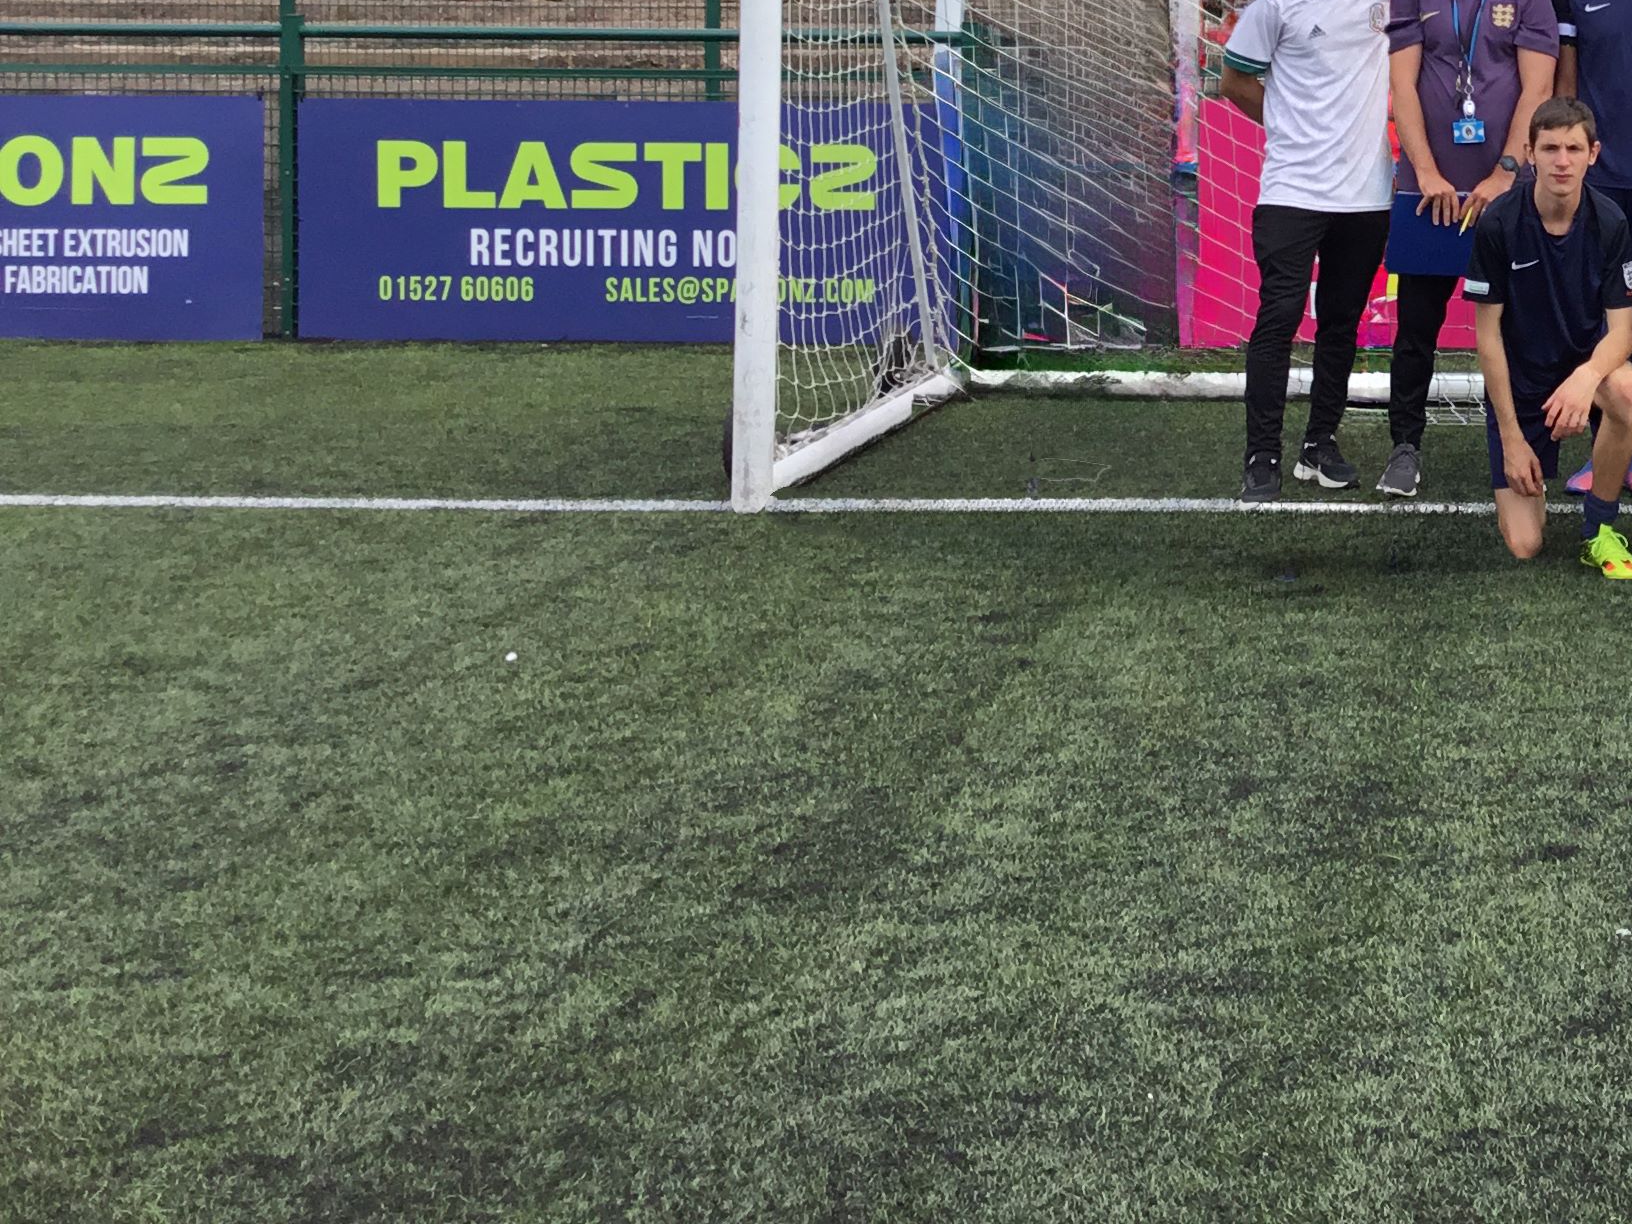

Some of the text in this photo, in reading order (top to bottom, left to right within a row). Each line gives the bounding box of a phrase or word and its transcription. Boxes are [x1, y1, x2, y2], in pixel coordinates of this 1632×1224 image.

[0, 228, 189, 258] HEET EXTRUSION
[470, 228, 737, 268] RECRUITING NO
[4, 265, 149, 294] FABRICATION
[379, 275, 535, 303] 01527 60606
[604, 276, 875, 305] SALES@SPONZ.COM
